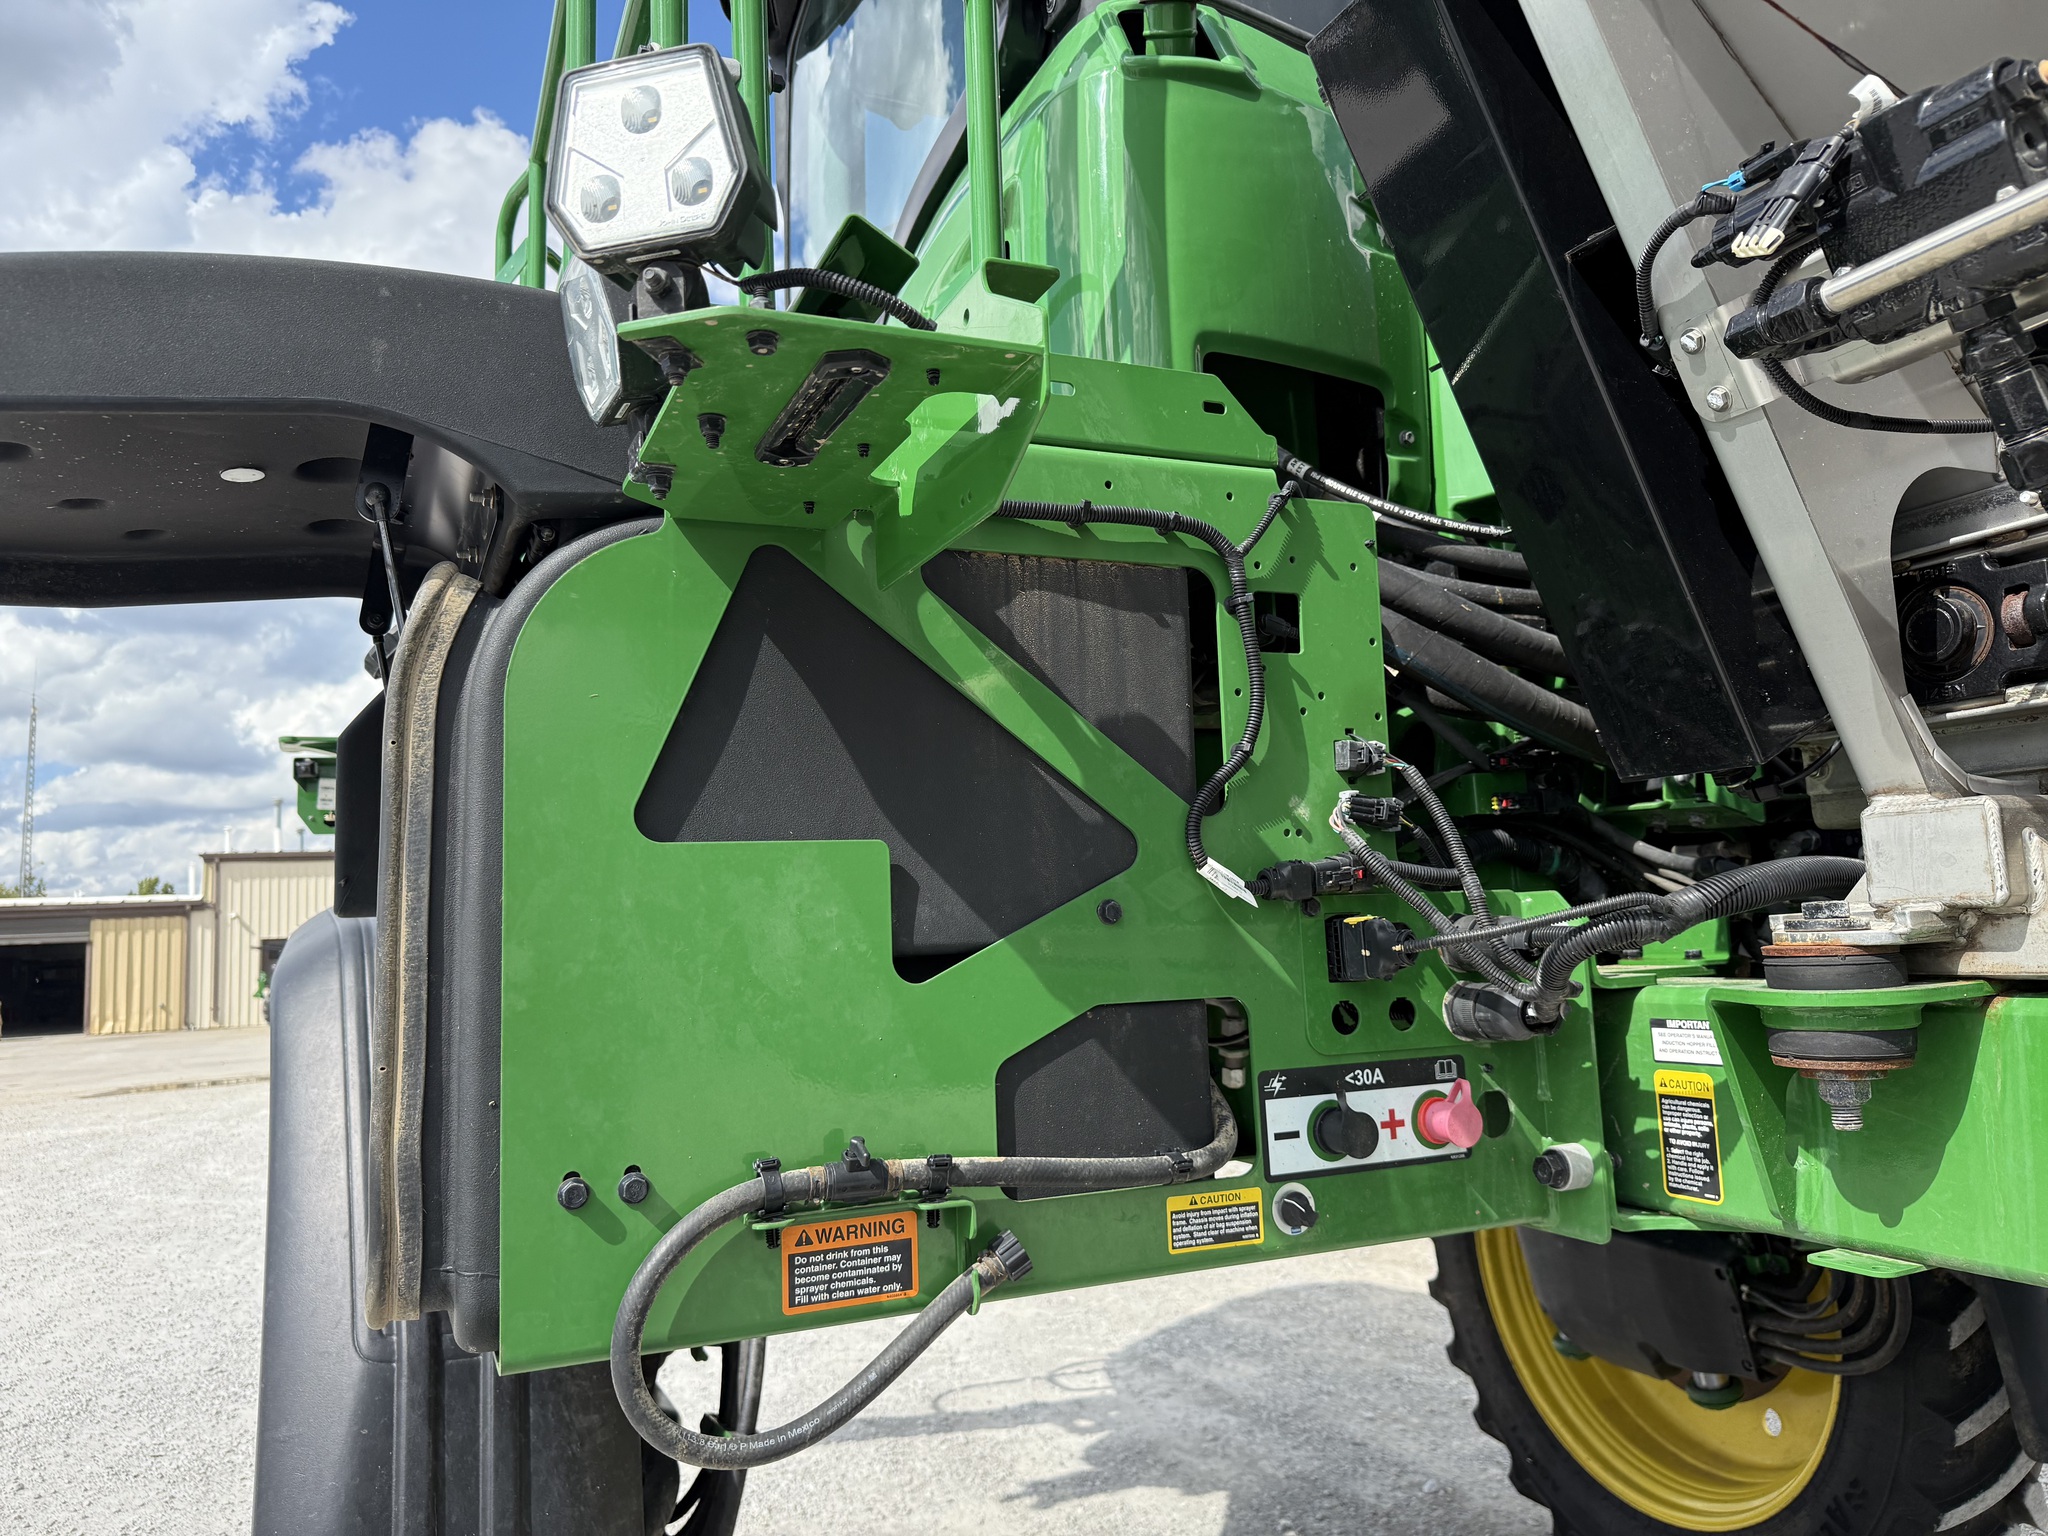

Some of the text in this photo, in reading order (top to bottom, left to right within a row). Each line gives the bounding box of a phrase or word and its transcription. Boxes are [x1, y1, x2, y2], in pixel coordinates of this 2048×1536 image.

[1666, 1019, 1710, 1030] IMPORTAN
[1344, 1068, 1385, 1086] <30A
[1668, 1079, 1710, 1092] CAUTION
[1662, 1098, 1686, 1106] Agricultural
[1682, 1178, 1703, 1186] chemical
[1200, 1192, 1241, 1204] CAUTION
[1186, 1211, 1200, 1219] injury
[1212, 1208, 1228, 1216] impact
[1238, 1204, 1256, 1212] sprayer
[815, 1218, 905, 1244] WARNING
[1182, 1224, 1202, 1232] deflation
[1216, 1222, 1225, 1230] bag
[1226, 1218, 1252, 1228] suspension
[1172, 1232, 1192, 1241] system.
[1173, 1236, 1214, 1248] operating system.
[794, 1244, 889, 1266] Do not drink from this
[794, 1254, 902, 1274] container. Container may
[794, 1262, 903, 1284] become contaminated by
[794, 1276, 877, 1296] sprayer chemicals.
[794, 1295, 809, 1306] Fill
[810, 1292, 830, 1303] with
[831, 1288, 855, 1300] clean
[856, 1285, 881, 1296] water
[882, 1282, 903, 1294] only.
[750, 1438, 776, 1450] Made
[777, 1434, 786, 1443] in
[788, 1416, 820, 1438] Mexico
